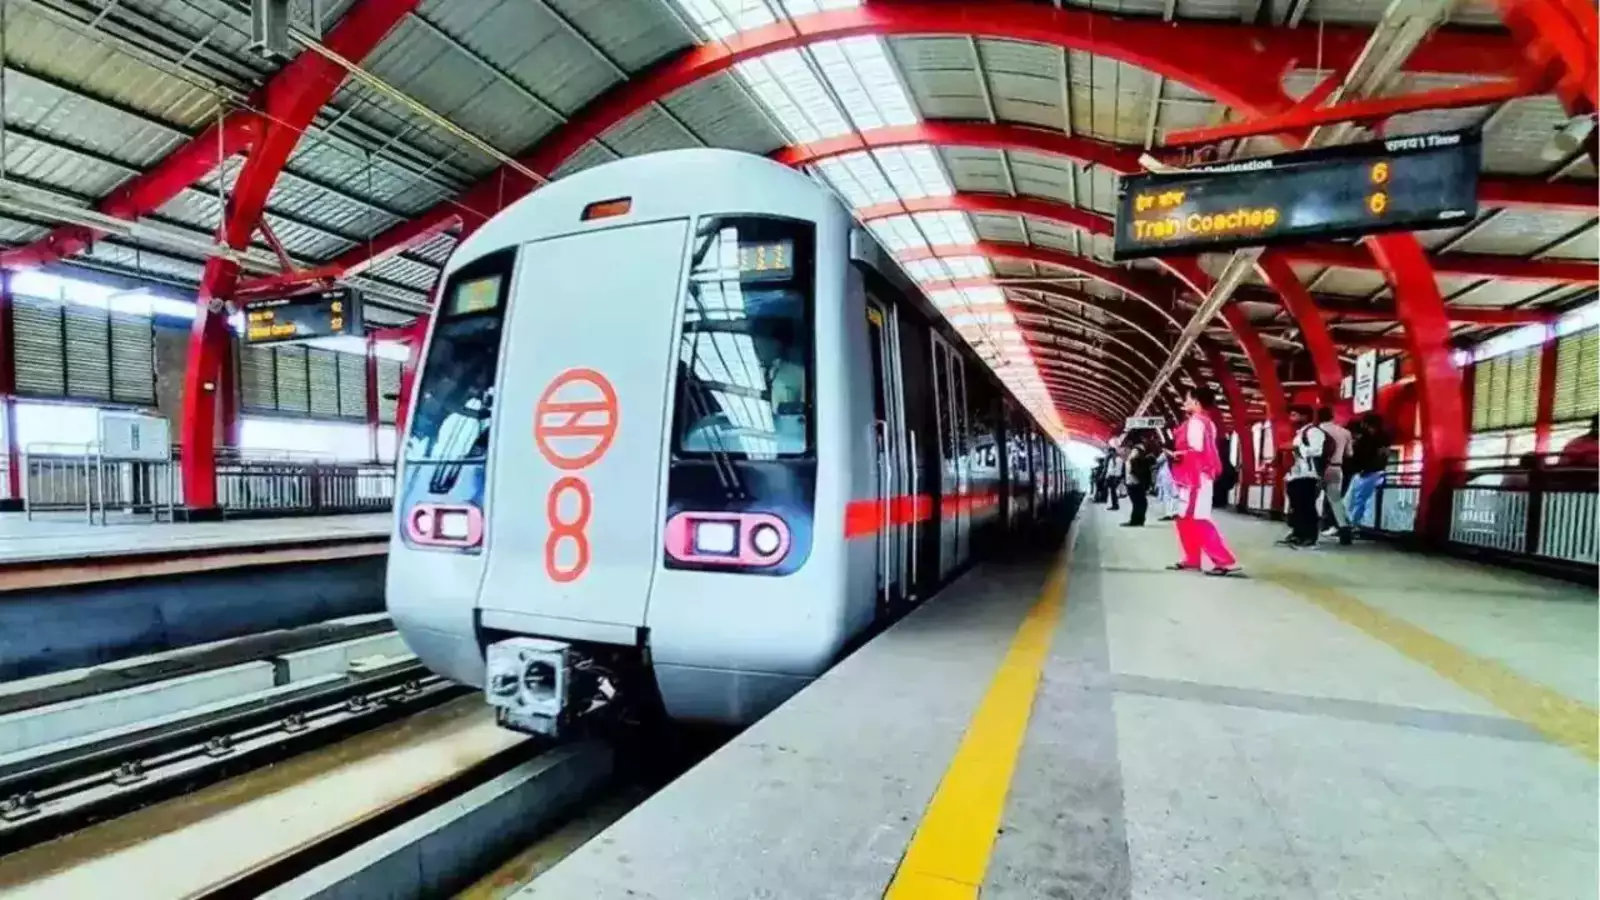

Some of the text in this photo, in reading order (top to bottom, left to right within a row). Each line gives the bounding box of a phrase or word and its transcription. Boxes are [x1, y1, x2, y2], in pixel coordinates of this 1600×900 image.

[1372, 162, 1388, 183] 6
[1370, 192, 1386, 214] 6
[1134, 207, 1279, 242] Train Coaches
[545, 475, 592, 584] 8
